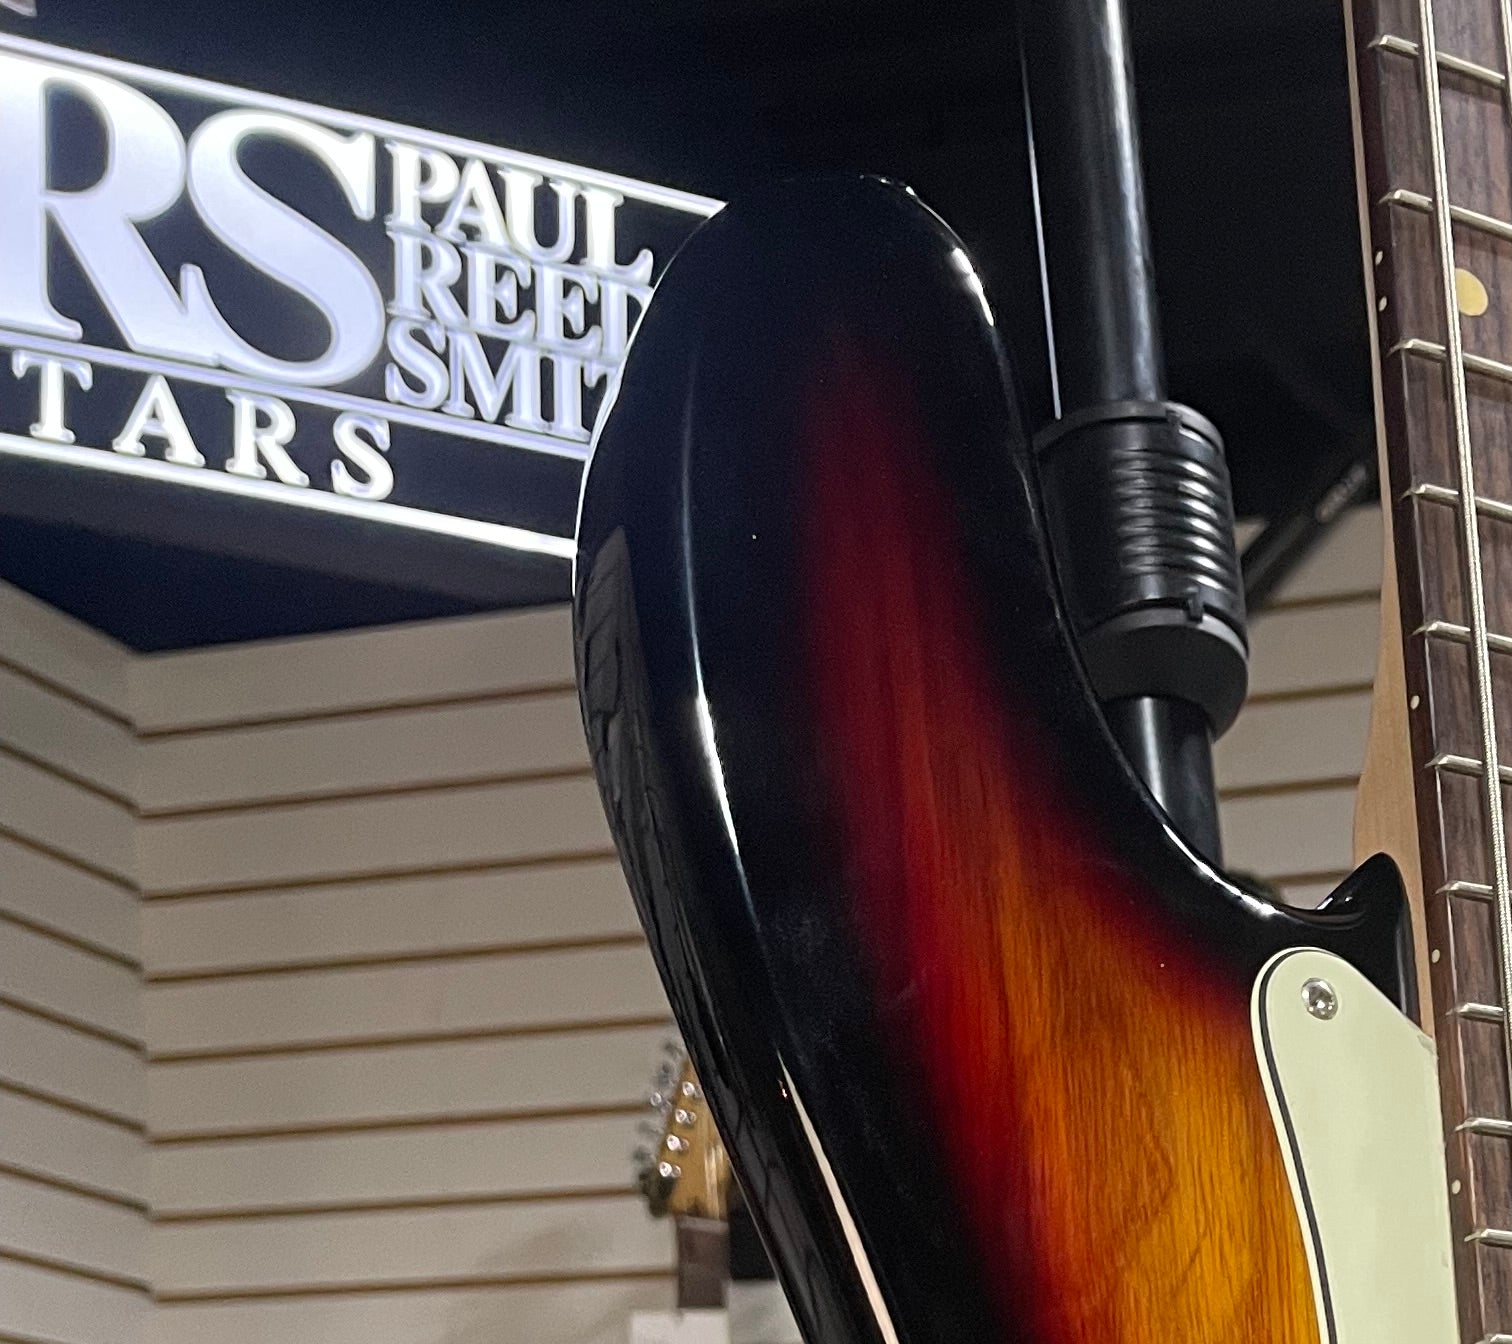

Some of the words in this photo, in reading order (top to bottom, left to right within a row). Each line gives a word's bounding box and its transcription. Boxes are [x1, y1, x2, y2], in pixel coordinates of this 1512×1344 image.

[385, 139, 653, 282] PAUL
[12, 349, 394, 501] TARS
[385, 317, 621, 443] SMI
